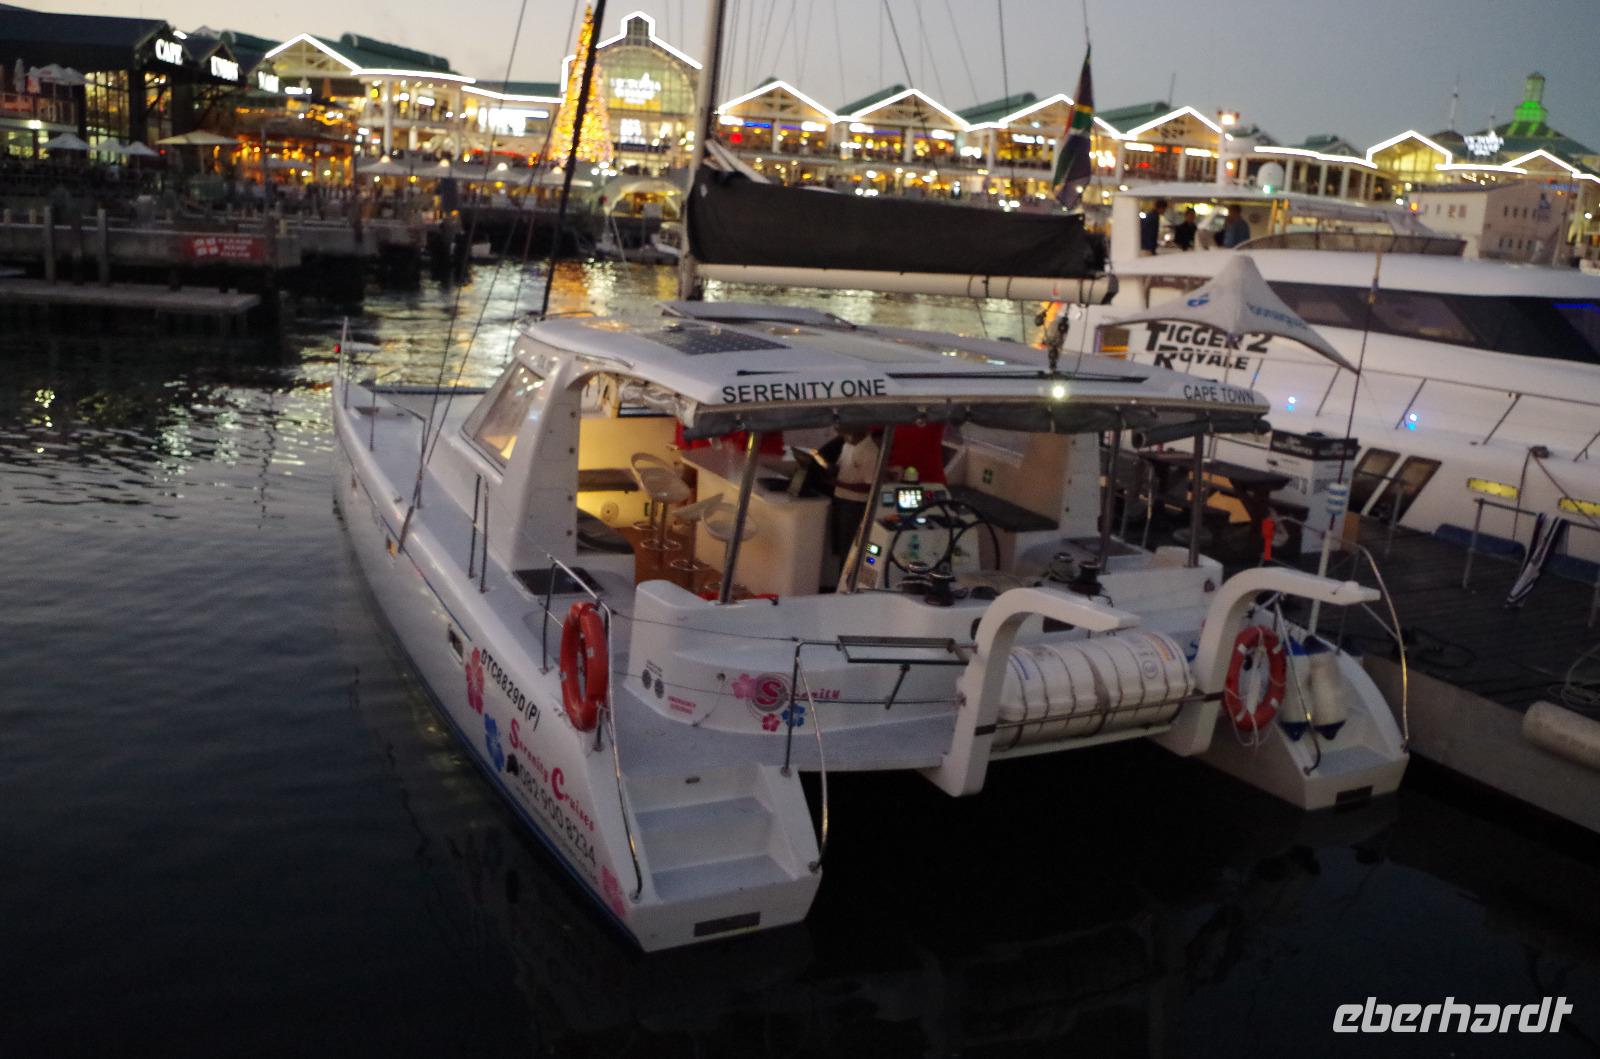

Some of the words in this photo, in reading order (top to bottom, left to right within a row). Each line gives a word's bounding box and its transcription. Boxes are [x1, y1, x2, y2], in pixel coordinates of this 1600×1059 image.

[1153, 345, 1250, 370] ROYALE
[722, 381, 834, 403] SERENITY
[840, 378, 887, 397] ONE
[1183, 385, 1217, 401] CAPE
[1221, 388, 1255, 403] TOWN
